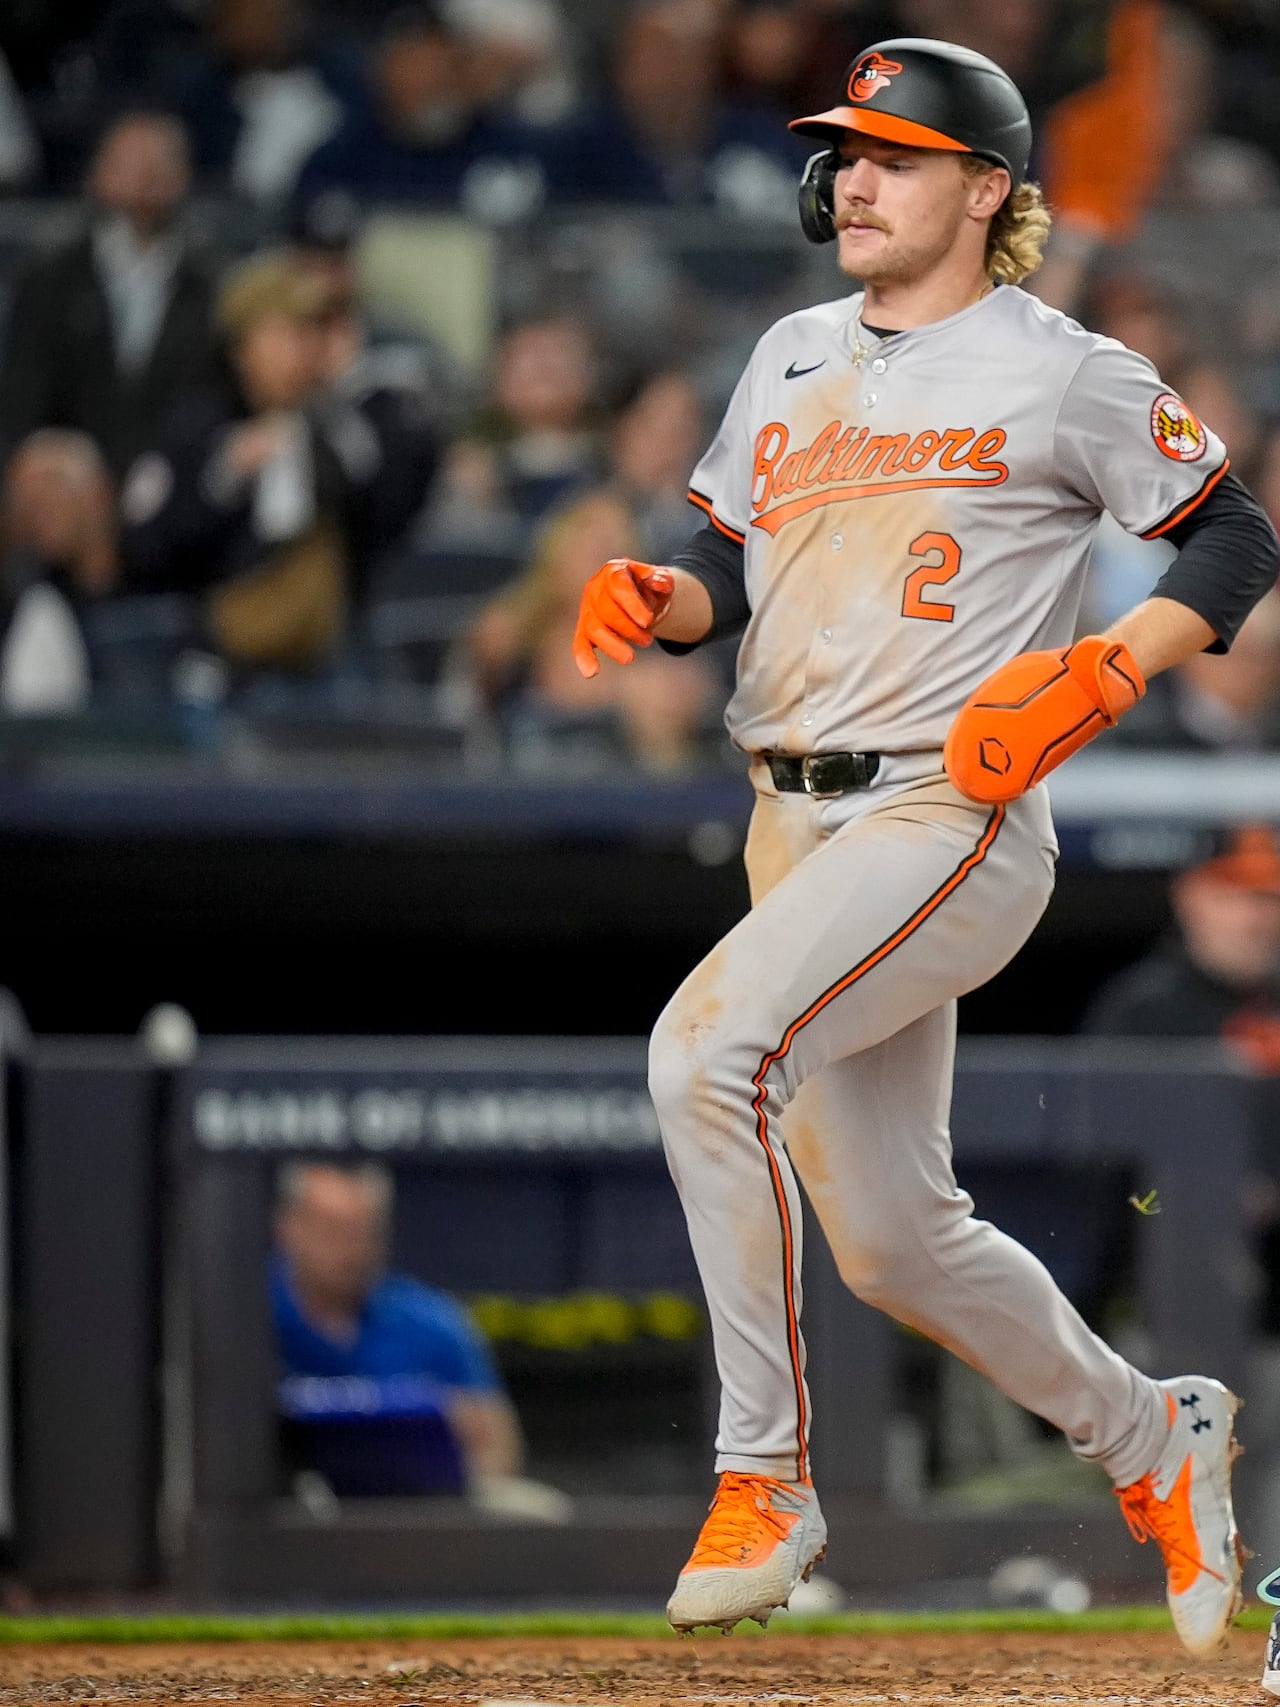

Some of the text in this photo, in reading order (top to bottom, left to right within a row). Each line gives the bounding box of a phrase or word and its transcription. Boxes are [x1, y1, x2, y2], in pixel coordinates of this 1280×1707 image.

[751, 420, 1009, 513] Baltimore
[901, 530, 962, 623] 2
[200, 1090, 346, 1149] BANK
